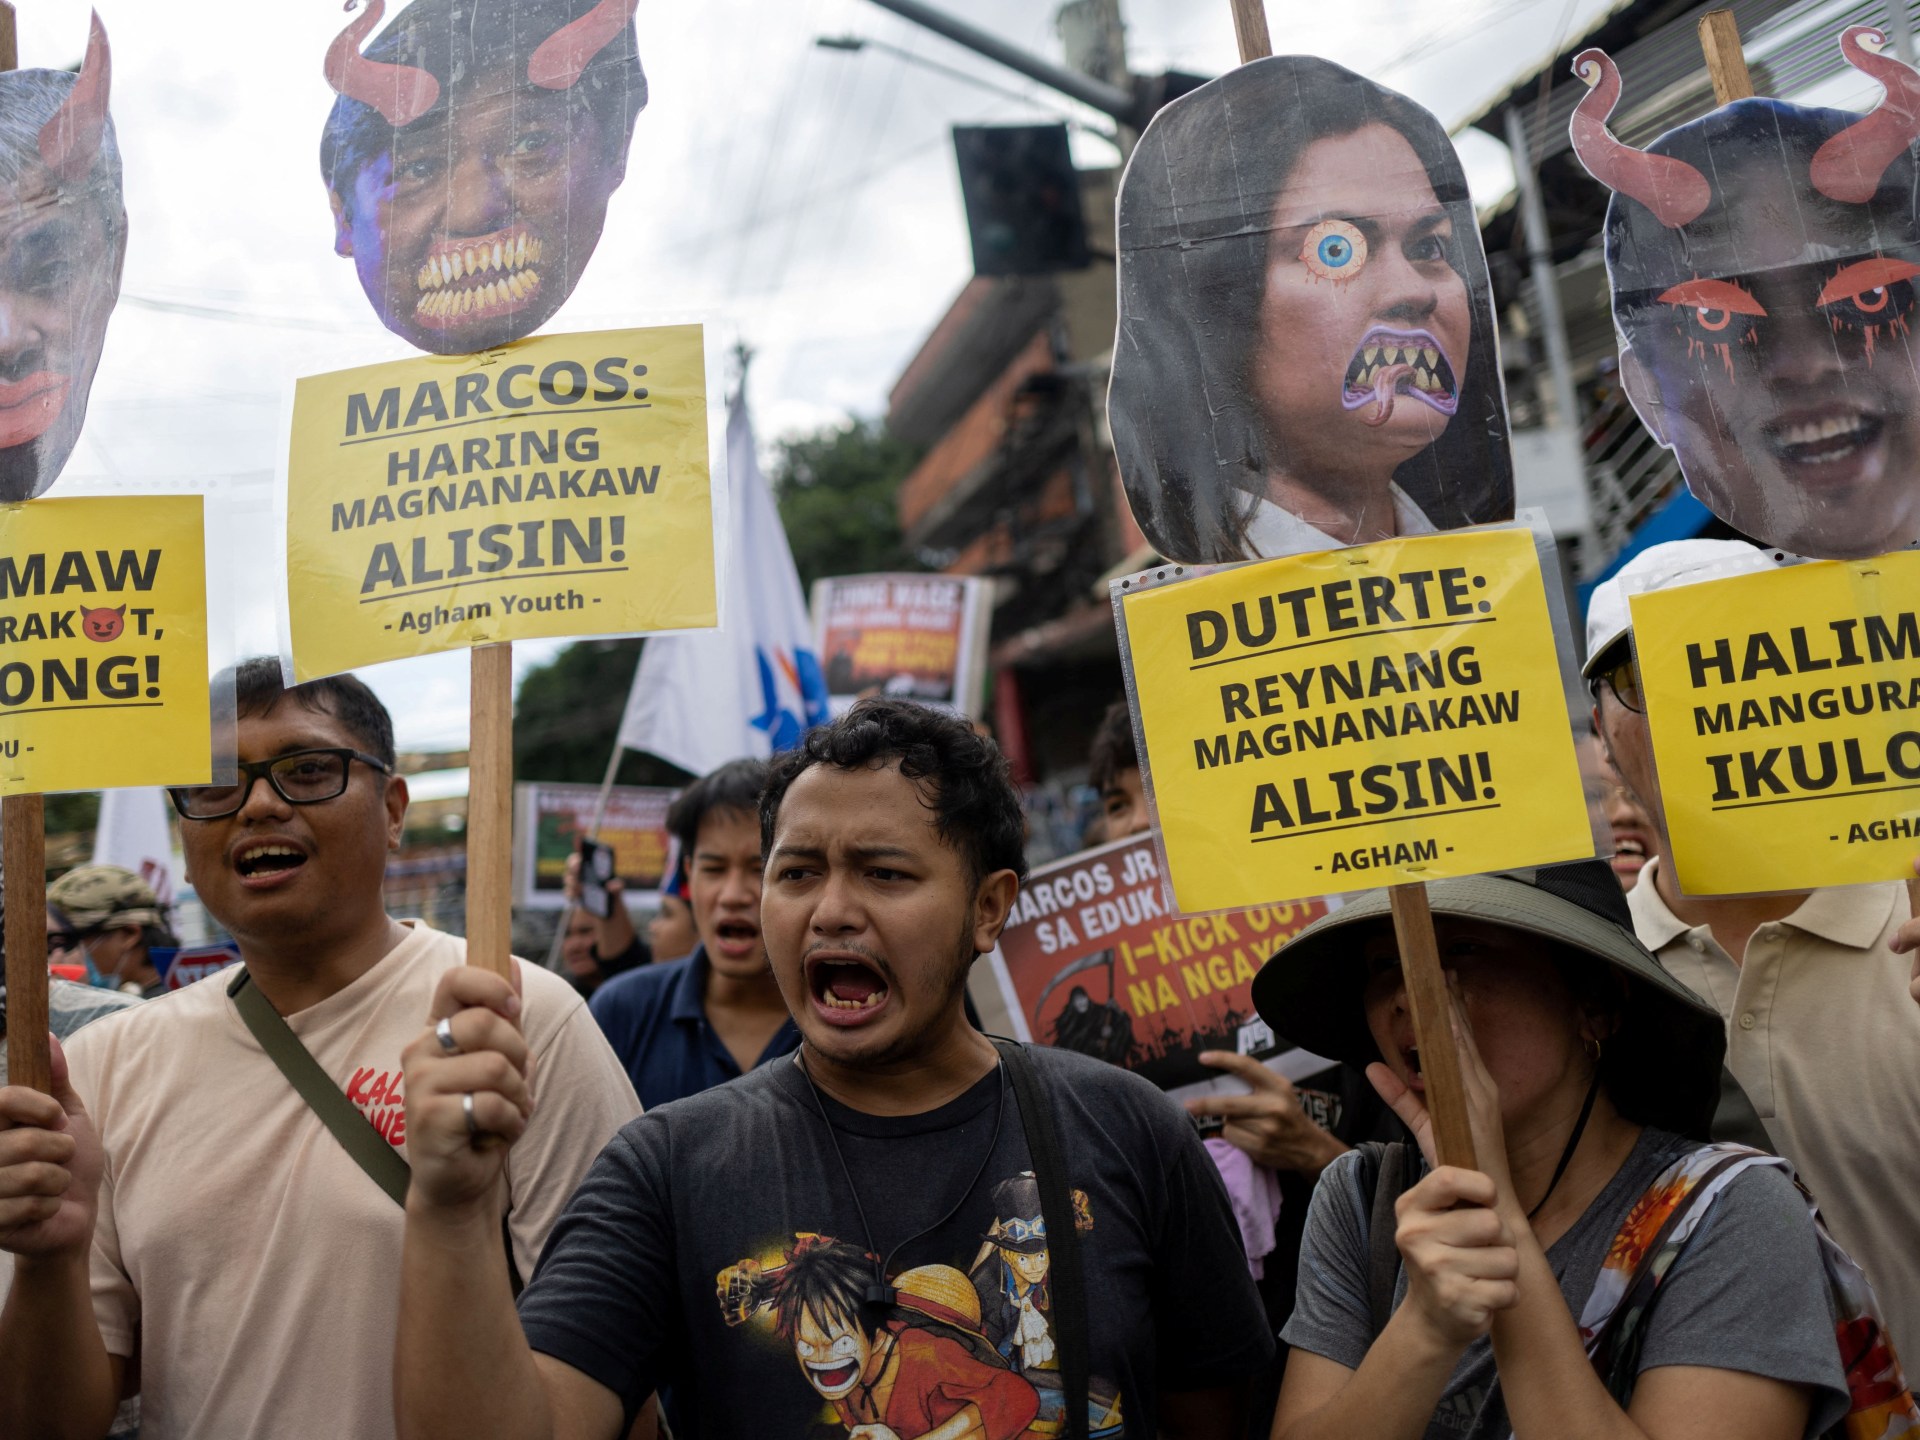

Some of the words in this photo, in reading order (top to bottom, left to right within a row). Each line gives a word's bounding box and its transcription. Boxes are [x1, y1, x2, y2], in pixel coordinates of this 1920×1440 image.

[344, 357, 649, 437] MARCOS:
[387, 427, 600, 486] HARING
[331, 464, 661, 532] MAGNANAKAW
[0, 549, 162, 600] MAW
[360, 515, 626, 594] ALISIN!
[399, 596, 492, 635] Agham
[500, 589, 585, 614] Youth
[1185, 567, 1493, 661] DUTERTE:
[0, 655, 161, 707] ONG!
[1686, 612, 1920, 689] HALIM
[1220, 646, 1482, 724] REYNANG
[0, 739, 19, 758] U
[1193, 690, 1520, 770] MAGNANAKAW
[1249, 751, 1497, 834] ALISIN!
[1706, 731, 1920, 801] IKULO
[1330, 839, 1439, 874] AGHAM
[1035, 915, 1080, 955] SA
[1119, 911, 1241, 976] I-KICK
[1127, 973, 1181, 1018] NA
[1180, 924, 1310, 1000] NGAY
[347, 1067, 405, 1106] KAL
